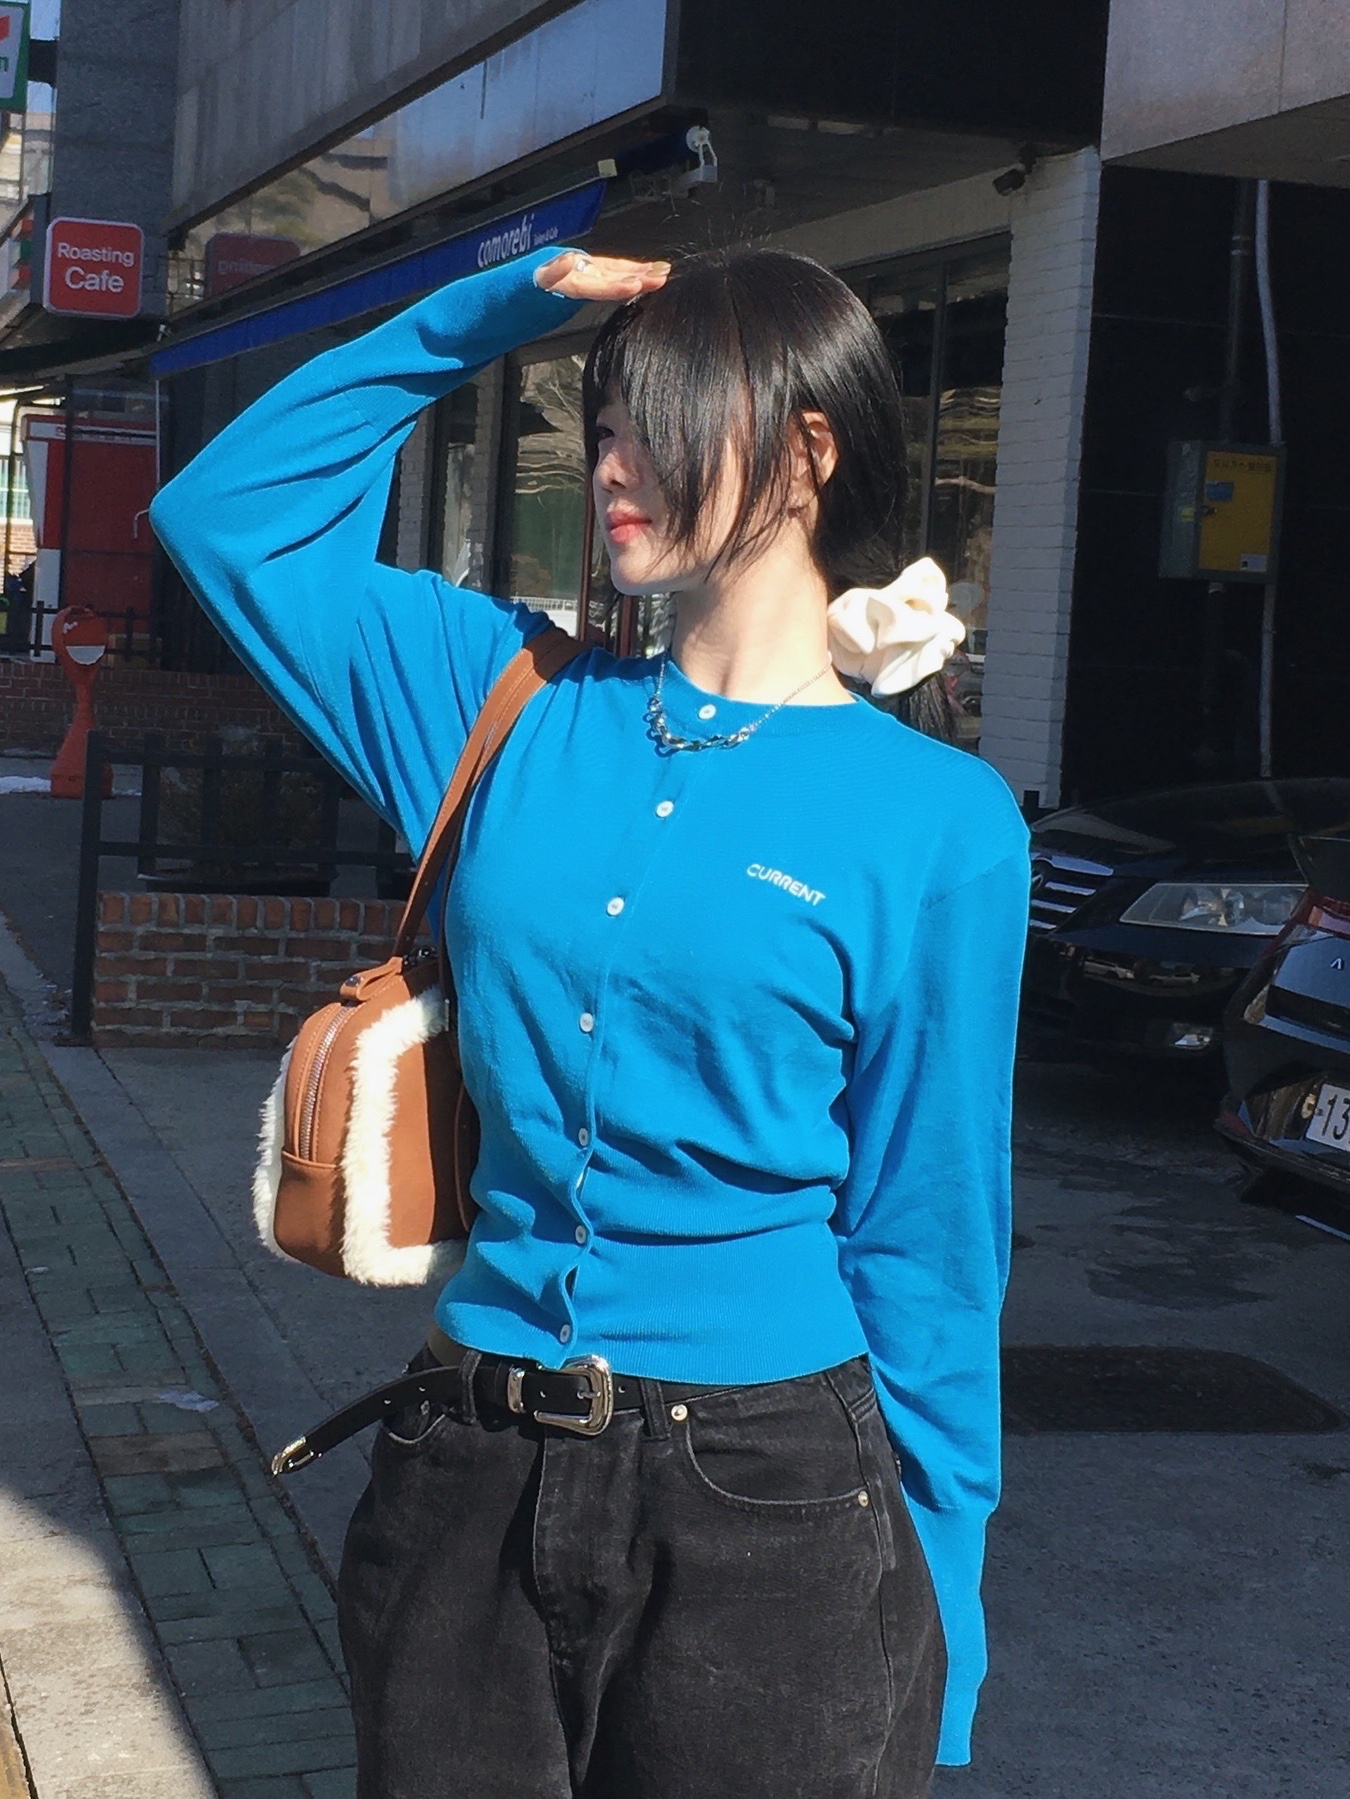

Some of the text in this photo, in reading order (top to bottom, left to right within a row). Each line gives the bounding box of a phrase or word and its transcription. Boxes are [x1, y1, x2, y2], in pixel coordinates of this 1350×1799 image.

[58, 242, 134, 267] Roasting
[65, 266, 124, 293] Cafe
[746, 863, 826, 906] CURRENT
